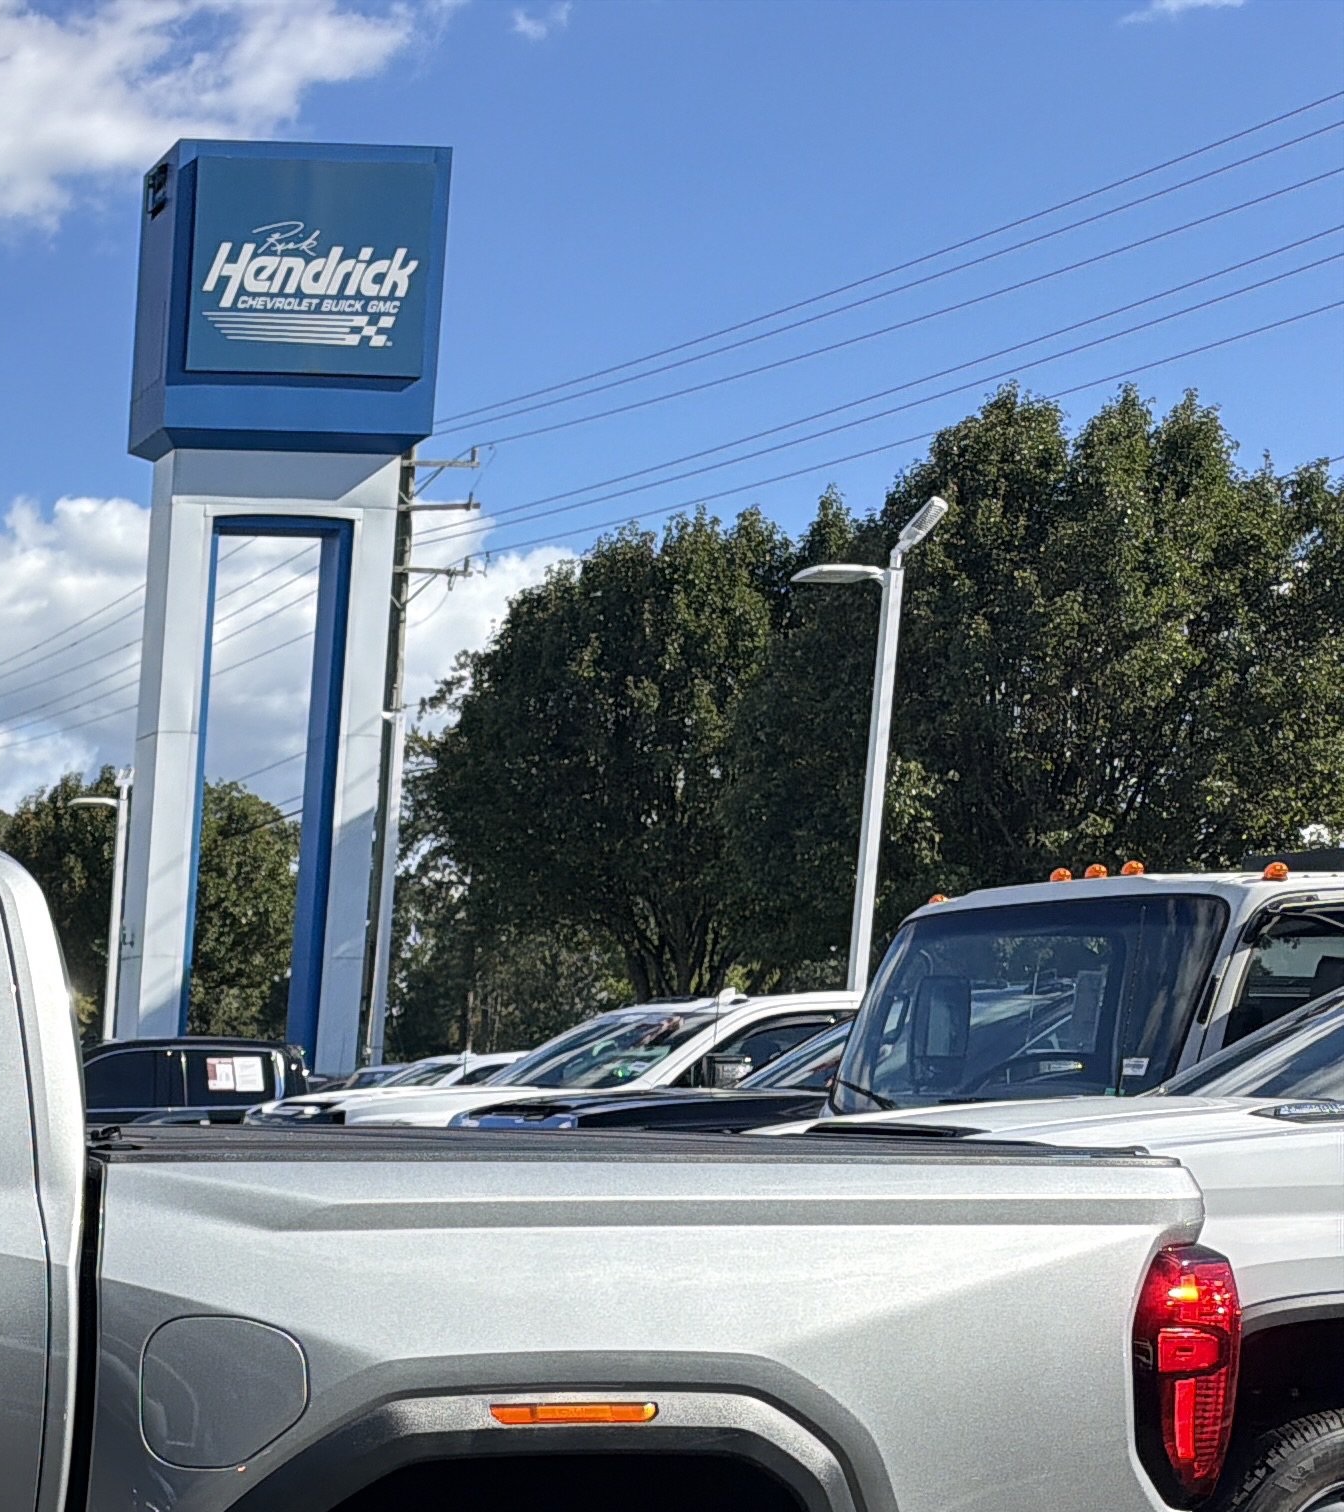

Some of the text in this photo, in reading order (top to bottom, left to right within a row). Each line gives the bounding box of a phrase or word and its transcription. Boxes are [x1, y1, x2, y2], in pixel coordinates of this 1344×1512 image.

[202, 241, 418, 308] Hendrick
[237, 295, 400, 313] CHEVROLET BUICK GMC
